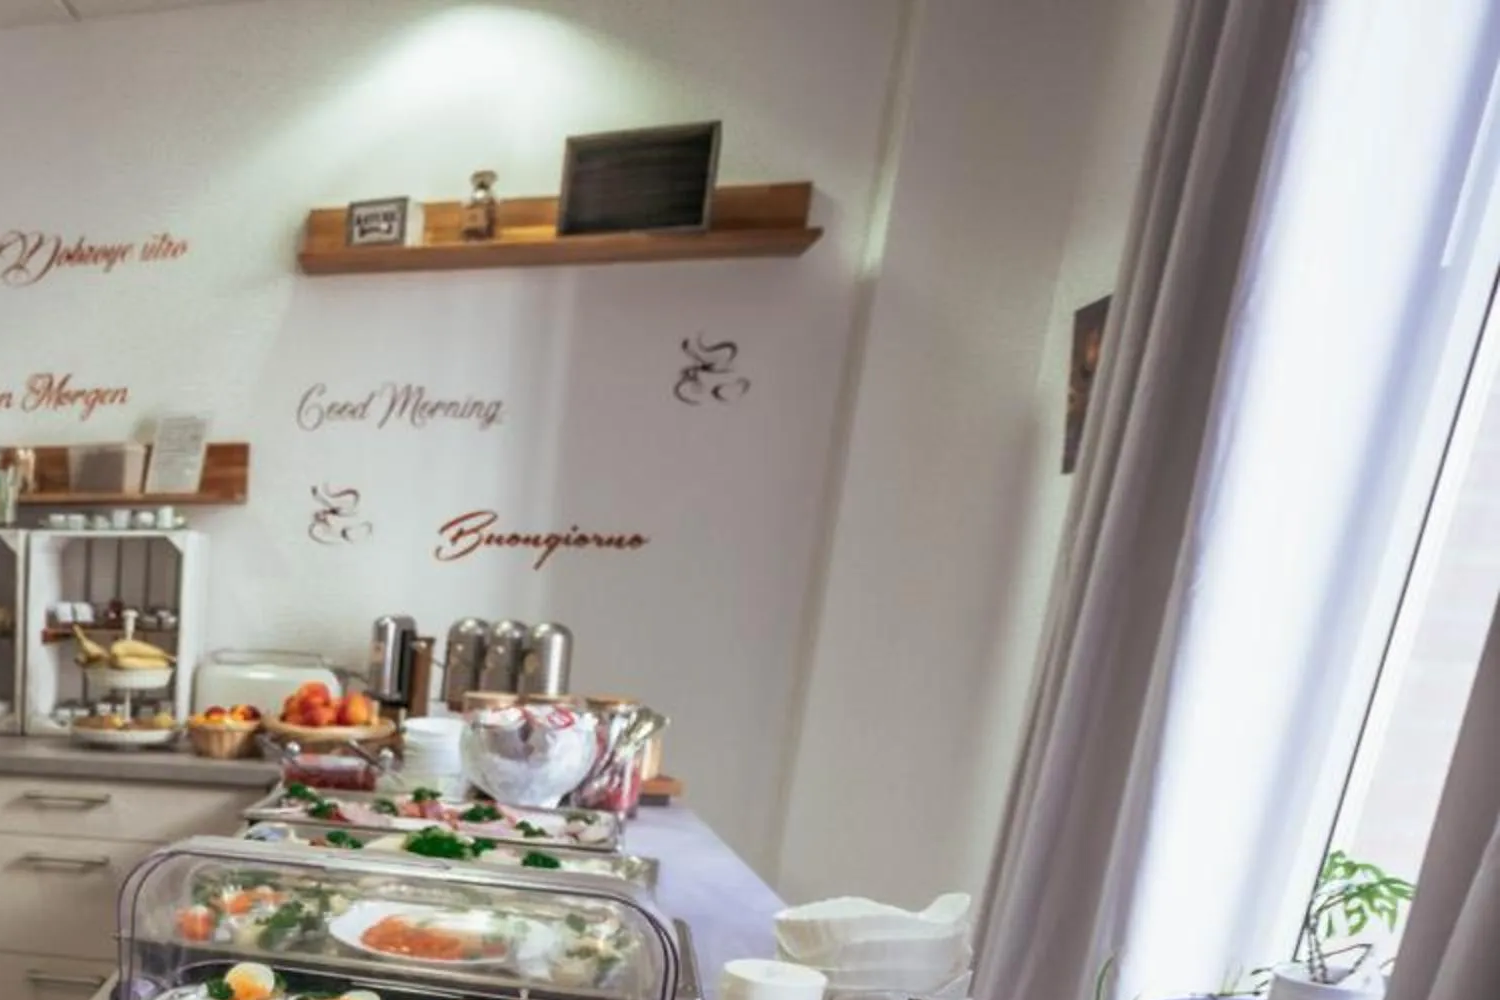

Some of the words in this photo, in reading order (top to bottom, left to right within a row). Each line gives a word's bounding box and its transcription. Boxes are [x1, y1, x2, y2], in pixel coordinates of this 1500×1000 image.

[21, 372, 129, 421] Morgen
[297, 382, 376, 432] Good
[377, 381, 504, 432] Morning
[434, 509, 649, 571] Buongiorno
